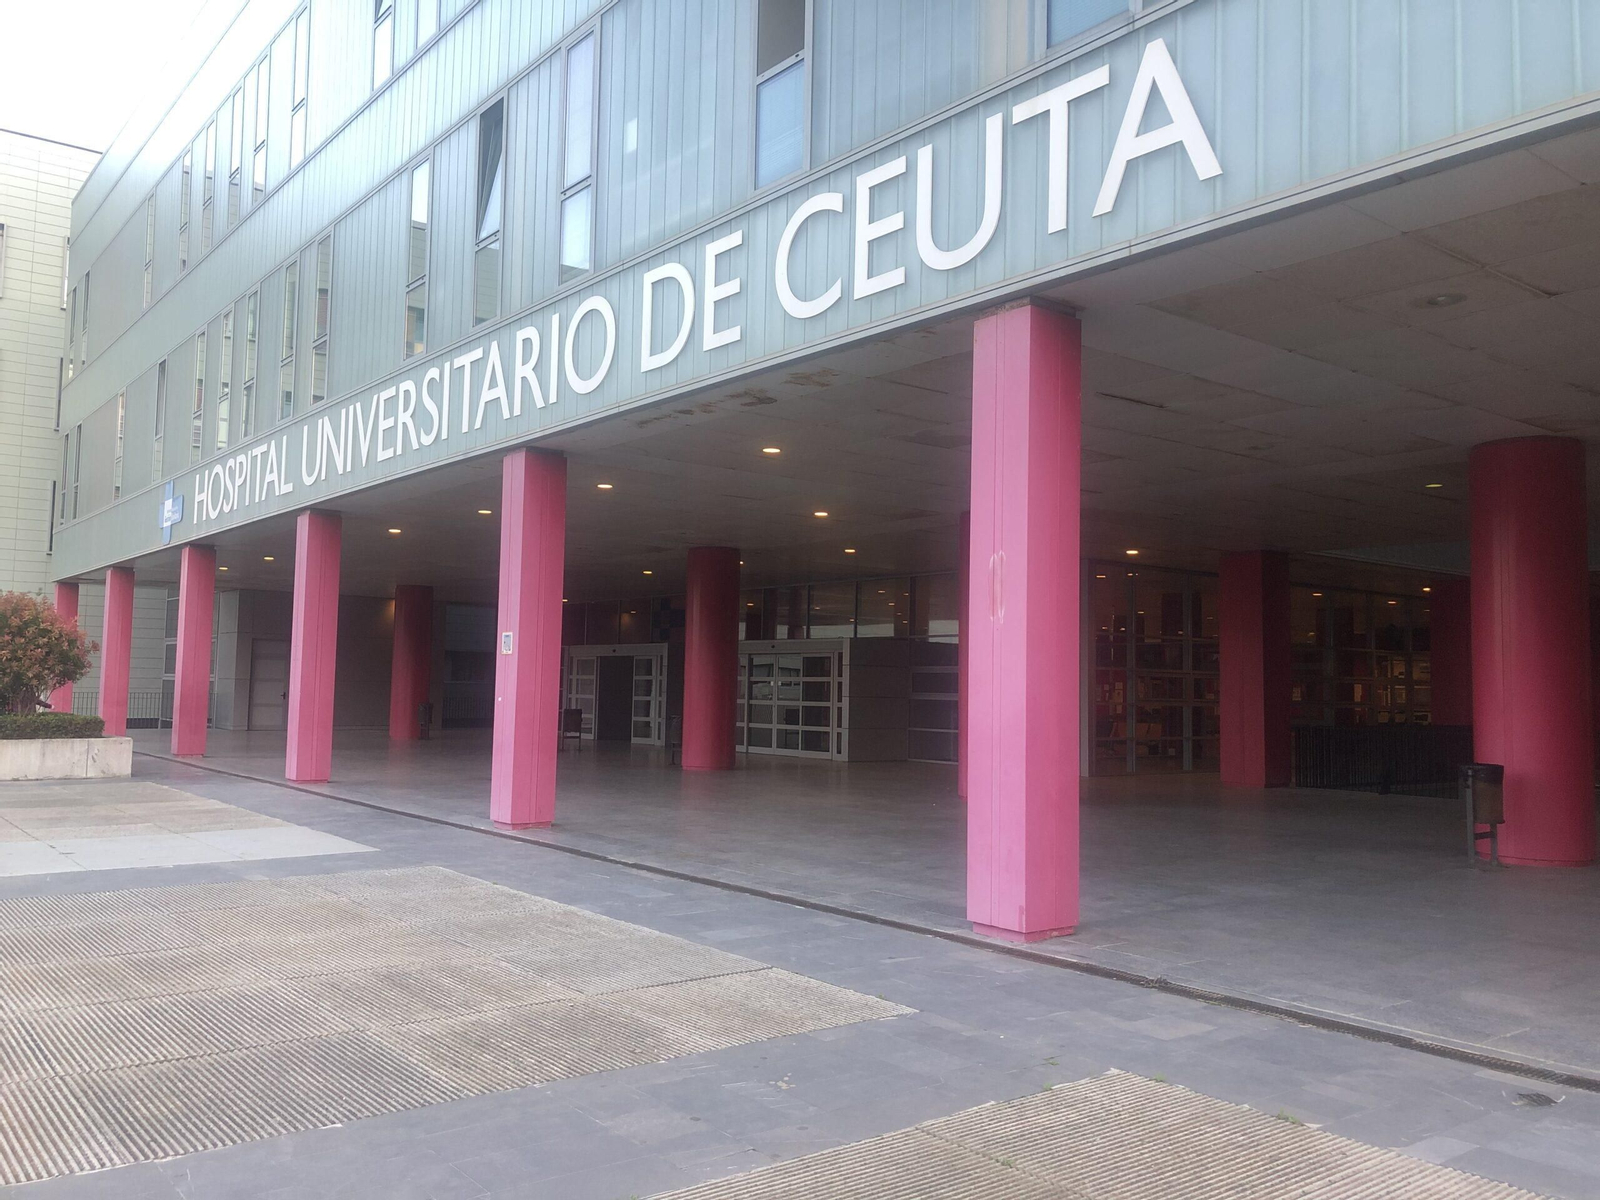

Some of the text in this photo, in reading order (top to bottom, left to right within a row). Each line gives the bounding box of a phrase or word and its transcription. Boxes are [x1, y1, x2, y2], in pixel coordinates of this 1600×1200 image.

[193, 38, 1222, 524] HOSPITAL UNIVERSITARIO DE CEUTA
